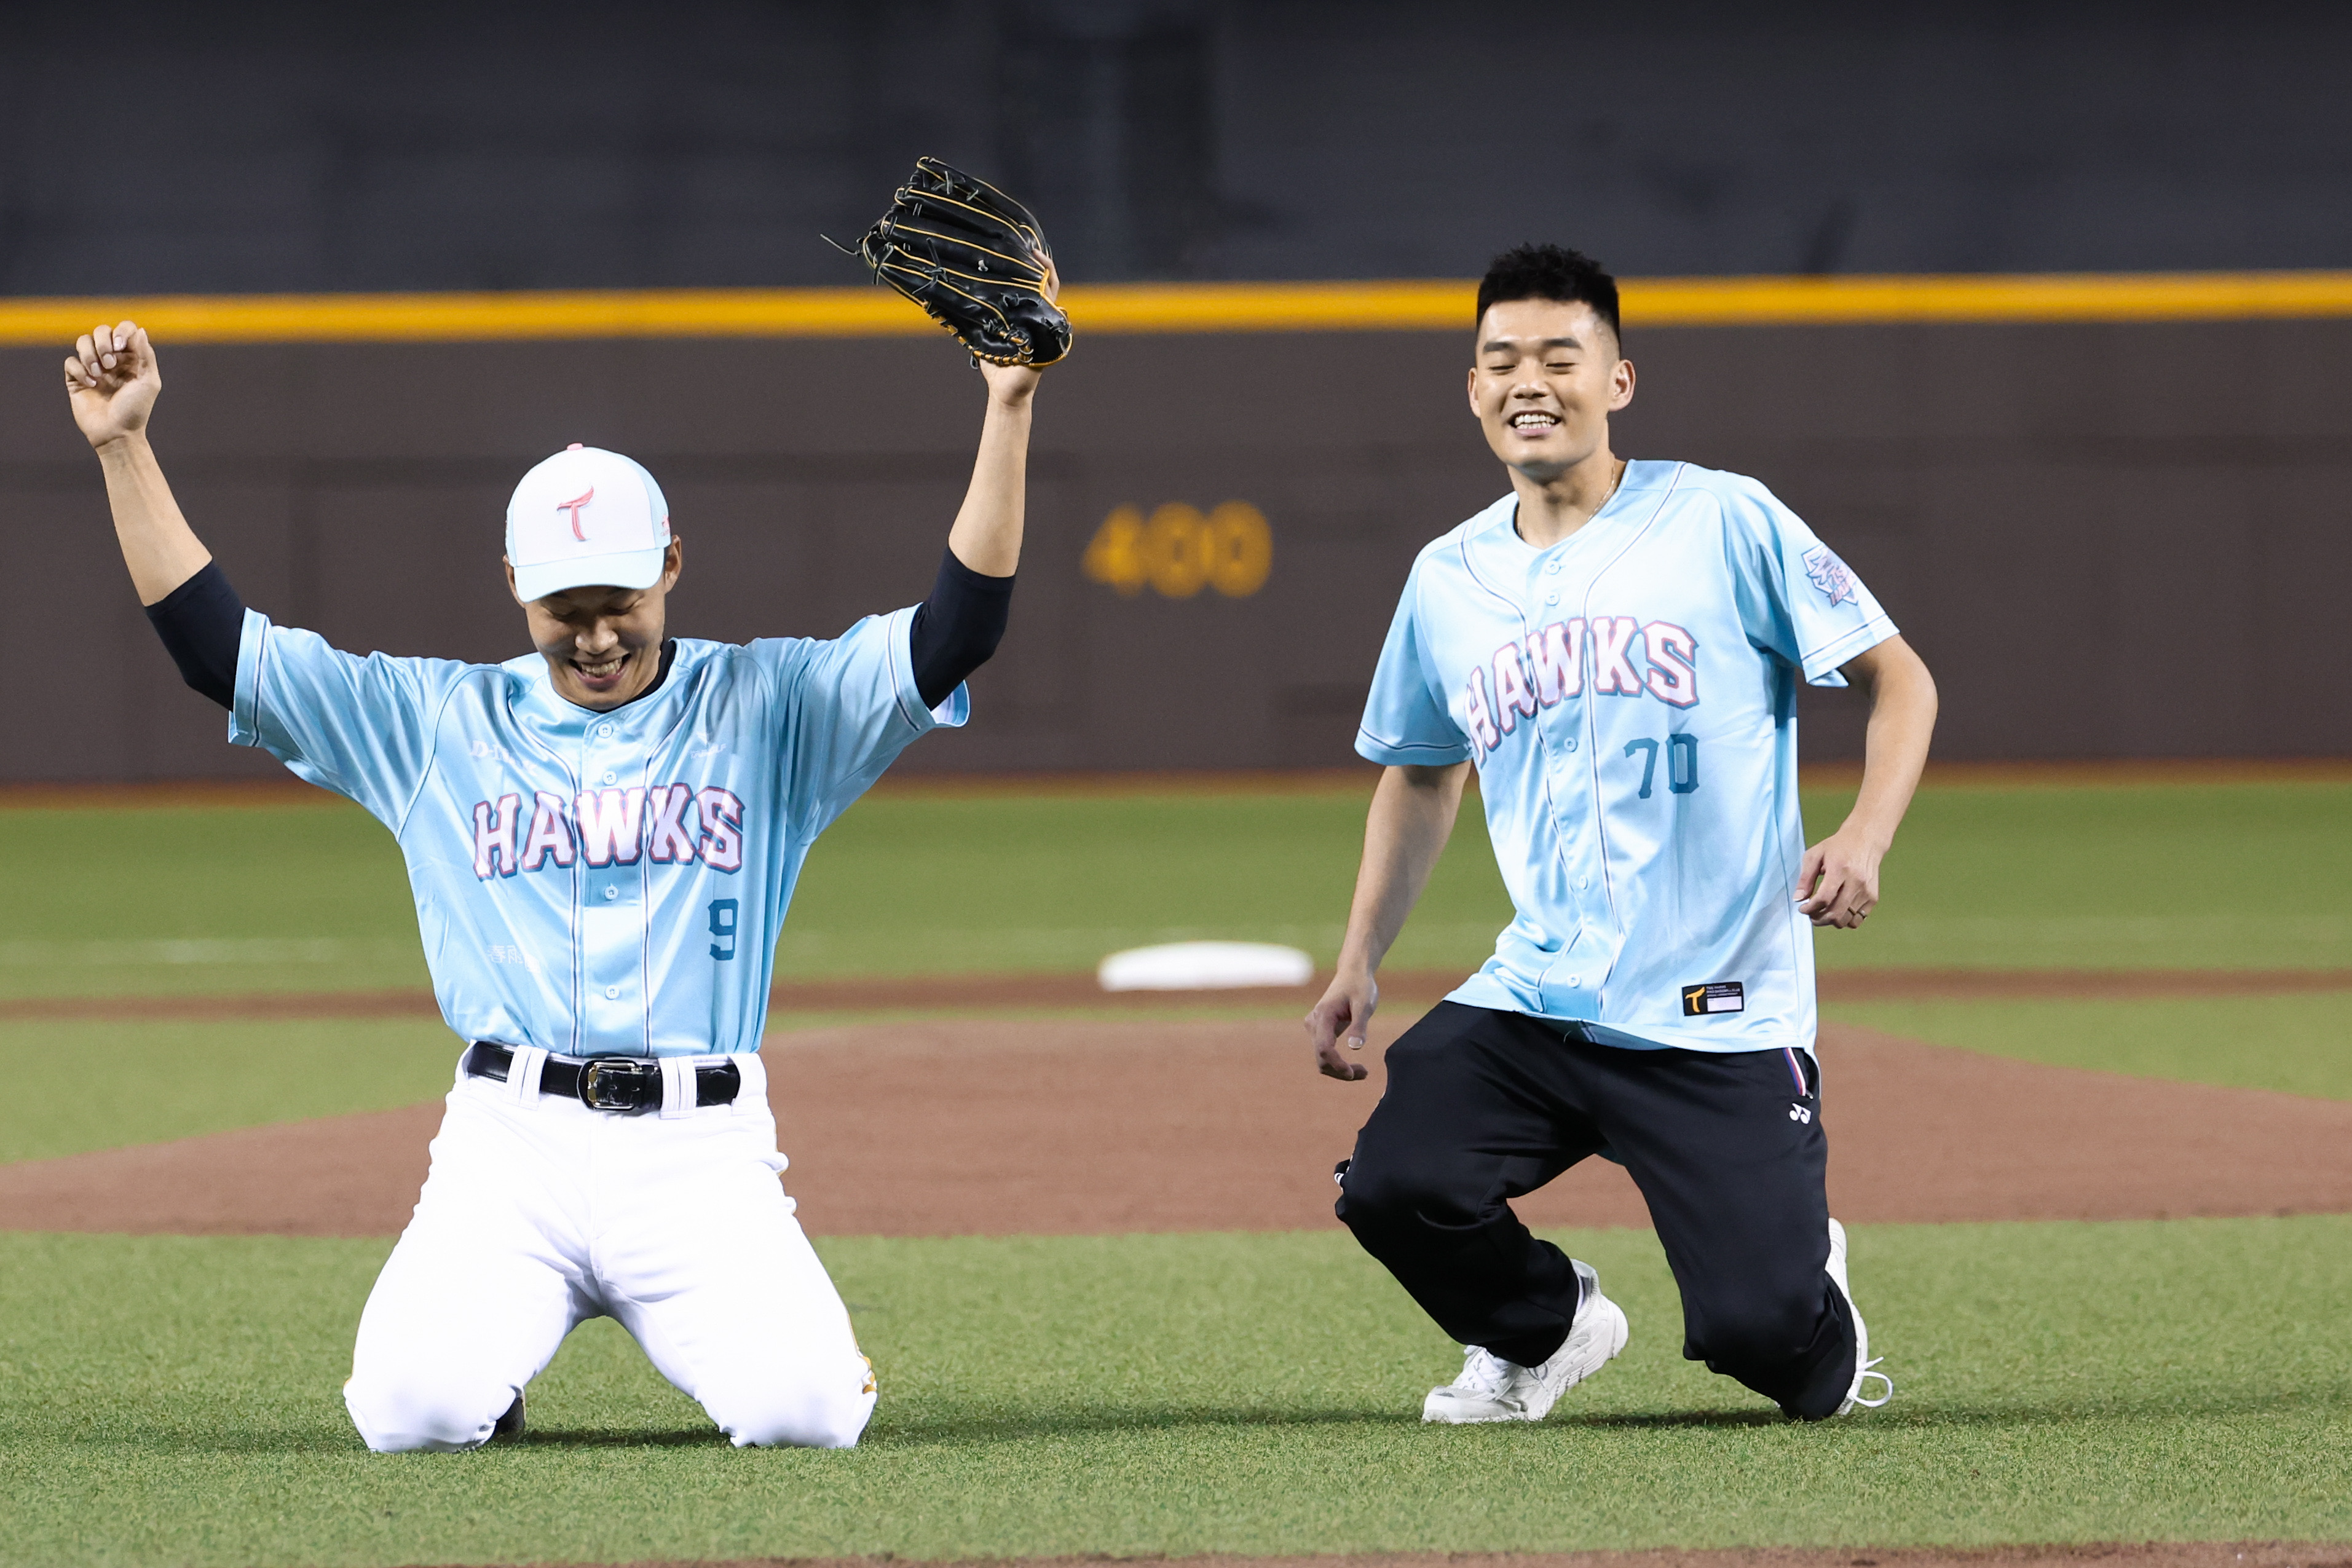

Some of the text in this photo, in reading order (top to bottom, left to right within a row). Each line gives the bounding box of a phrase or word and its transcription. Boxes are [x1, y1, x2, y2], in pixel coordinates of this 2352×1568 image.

[1081, 500, 1273, 598] 400
[1464, 616, 1700, 769] HAWKS
[1624, 733, 1700, 799] 70
[473, 782, 745, 882] HAWKS
[708, 898, 738, 961] 9
